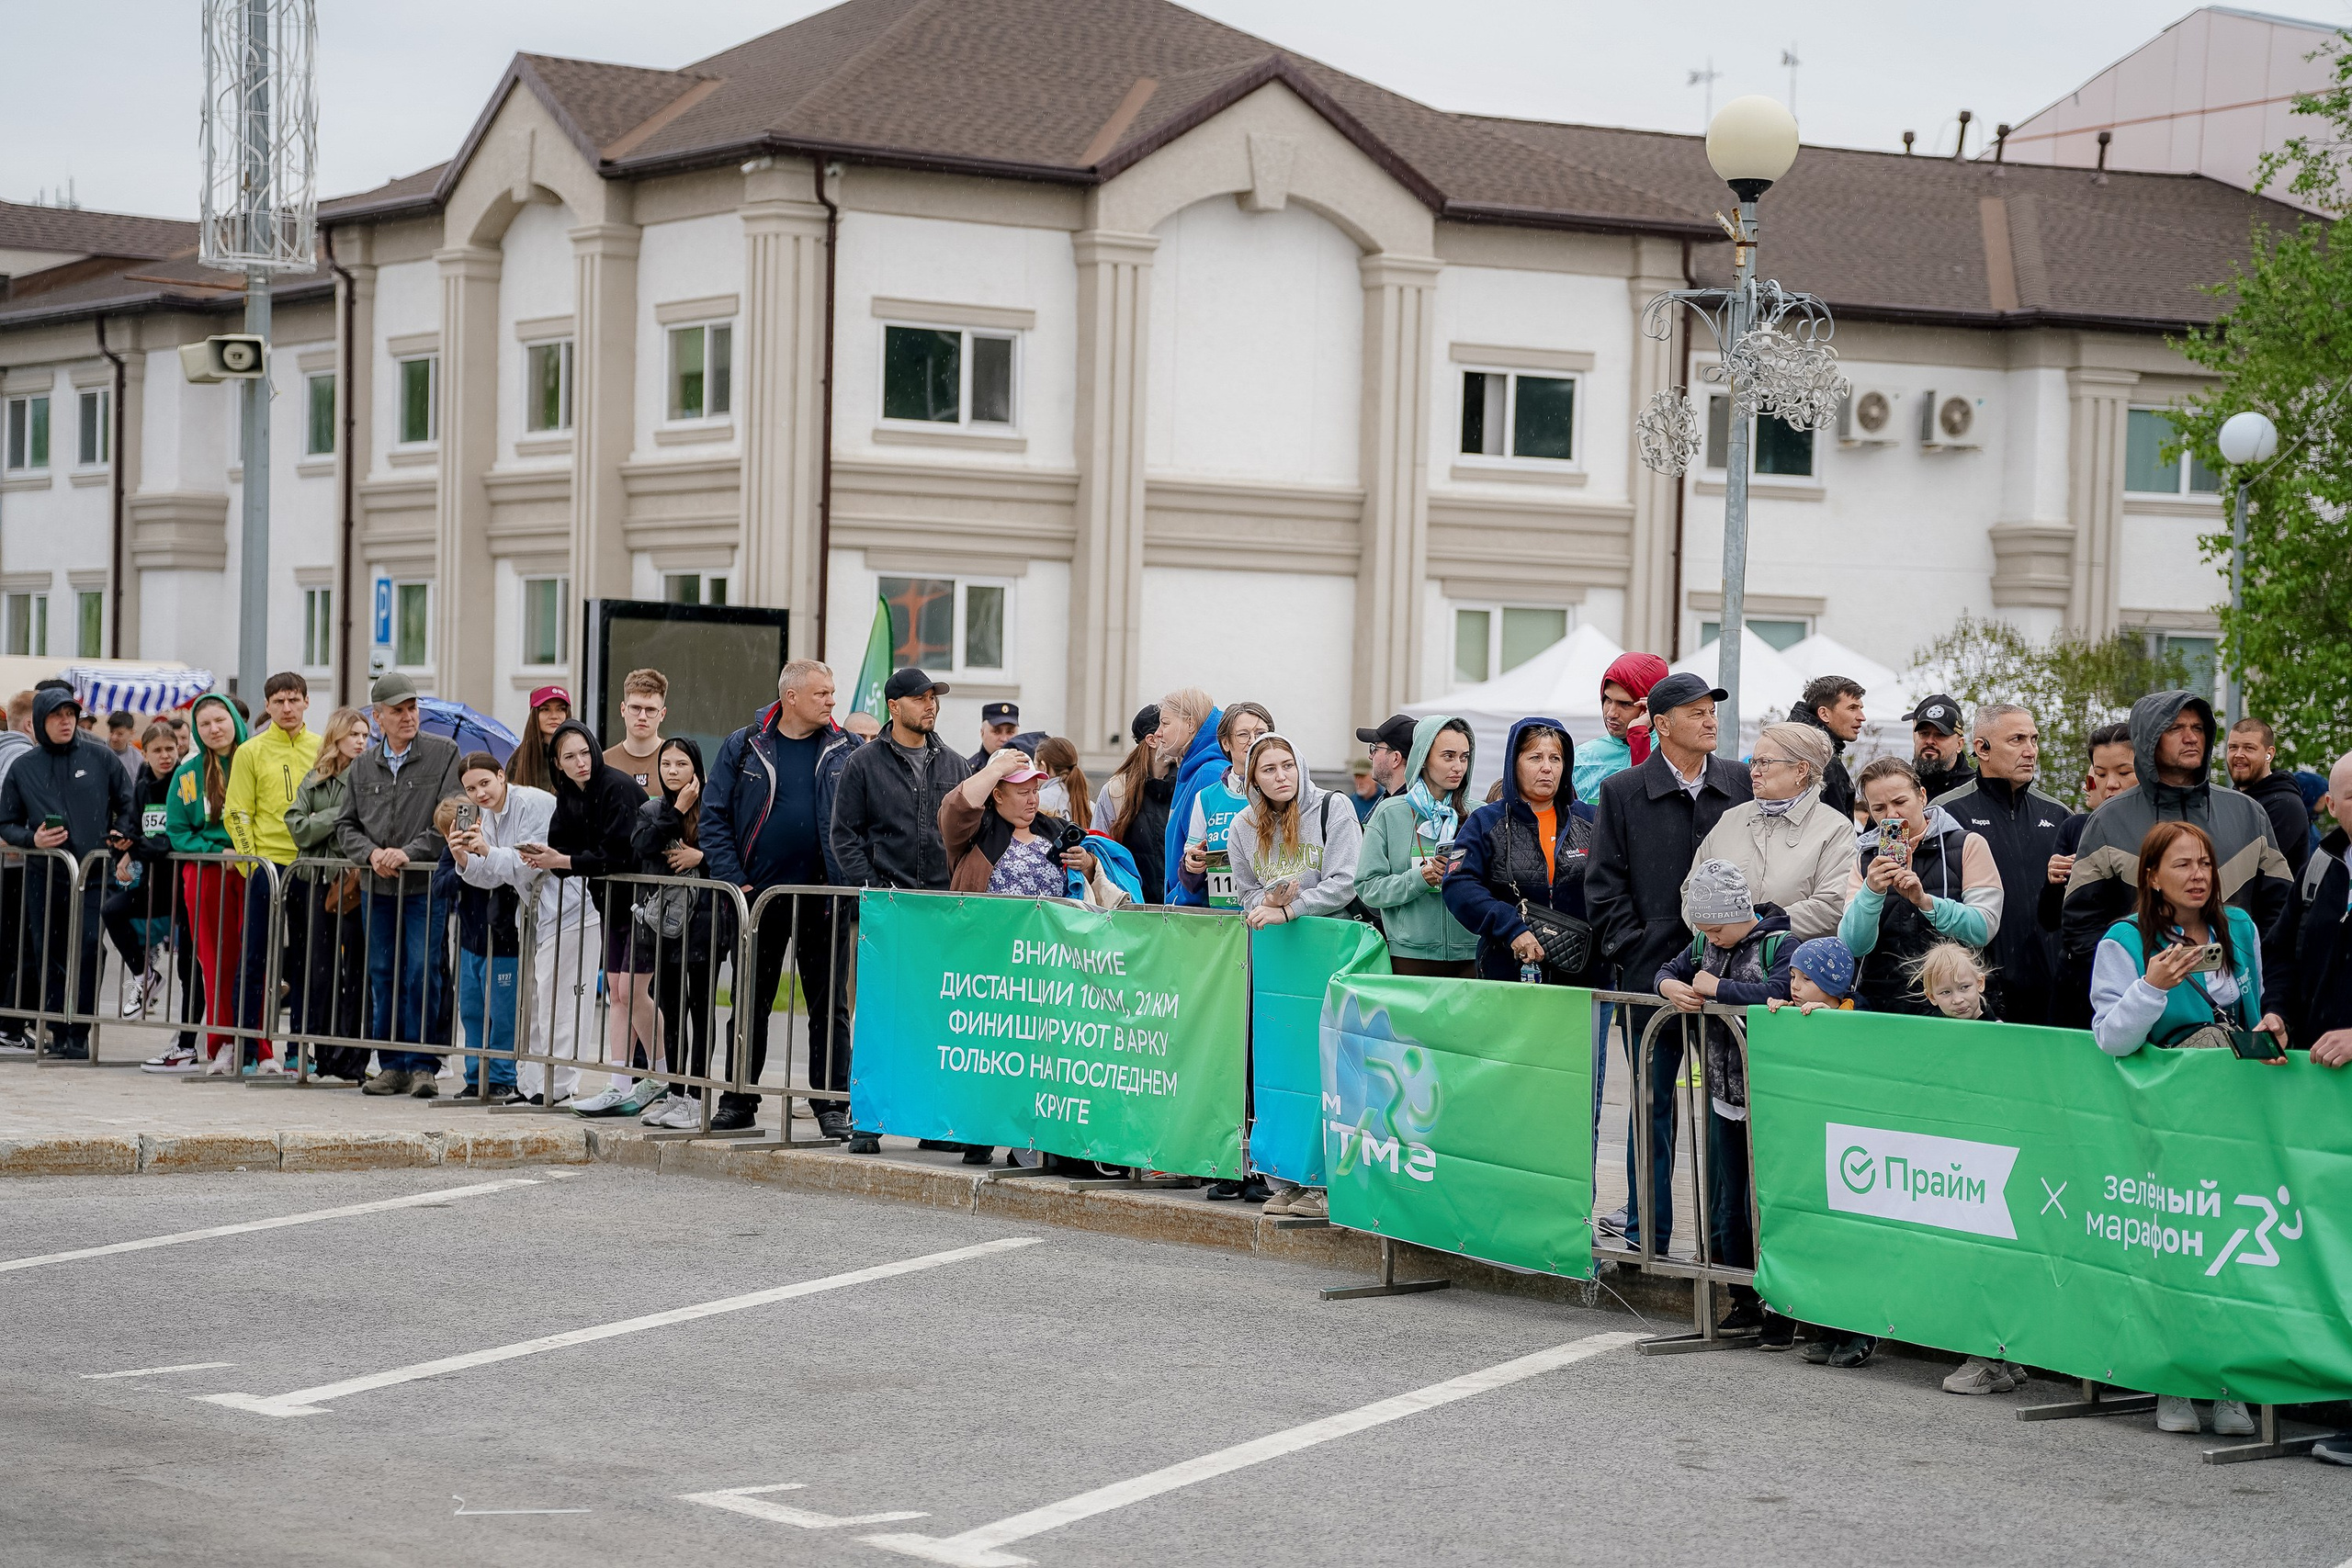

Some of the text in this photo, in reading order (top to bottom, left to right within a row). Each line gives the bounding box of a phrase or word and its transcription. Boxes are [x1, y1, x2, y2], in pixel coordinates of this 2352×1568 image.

[179, 770, 197, 806] N
[1208, 831, 1219, 842] за
[1214, 875, 1238, 893] 11
[1012, 939, 1127, 976] ВНИМАНИЕ
[940, 971, 1074, 1007] ДИСТАНЦИИ
[948, 1009, 1170, 1057] ФИНИШИРУЮТ В АРКУ
[936, 1045, 1178, 1098] ТОЛЬКО НА ПОСЛЕДНЕМ
[1035, 1091, 1091, 1125] КРУГЕ
[1884, 1156, 1986, 1204] Прайм
[2103, 1172, 2222, 1219] зелёный
[2086, 1211, 2203, 1259] марафон
